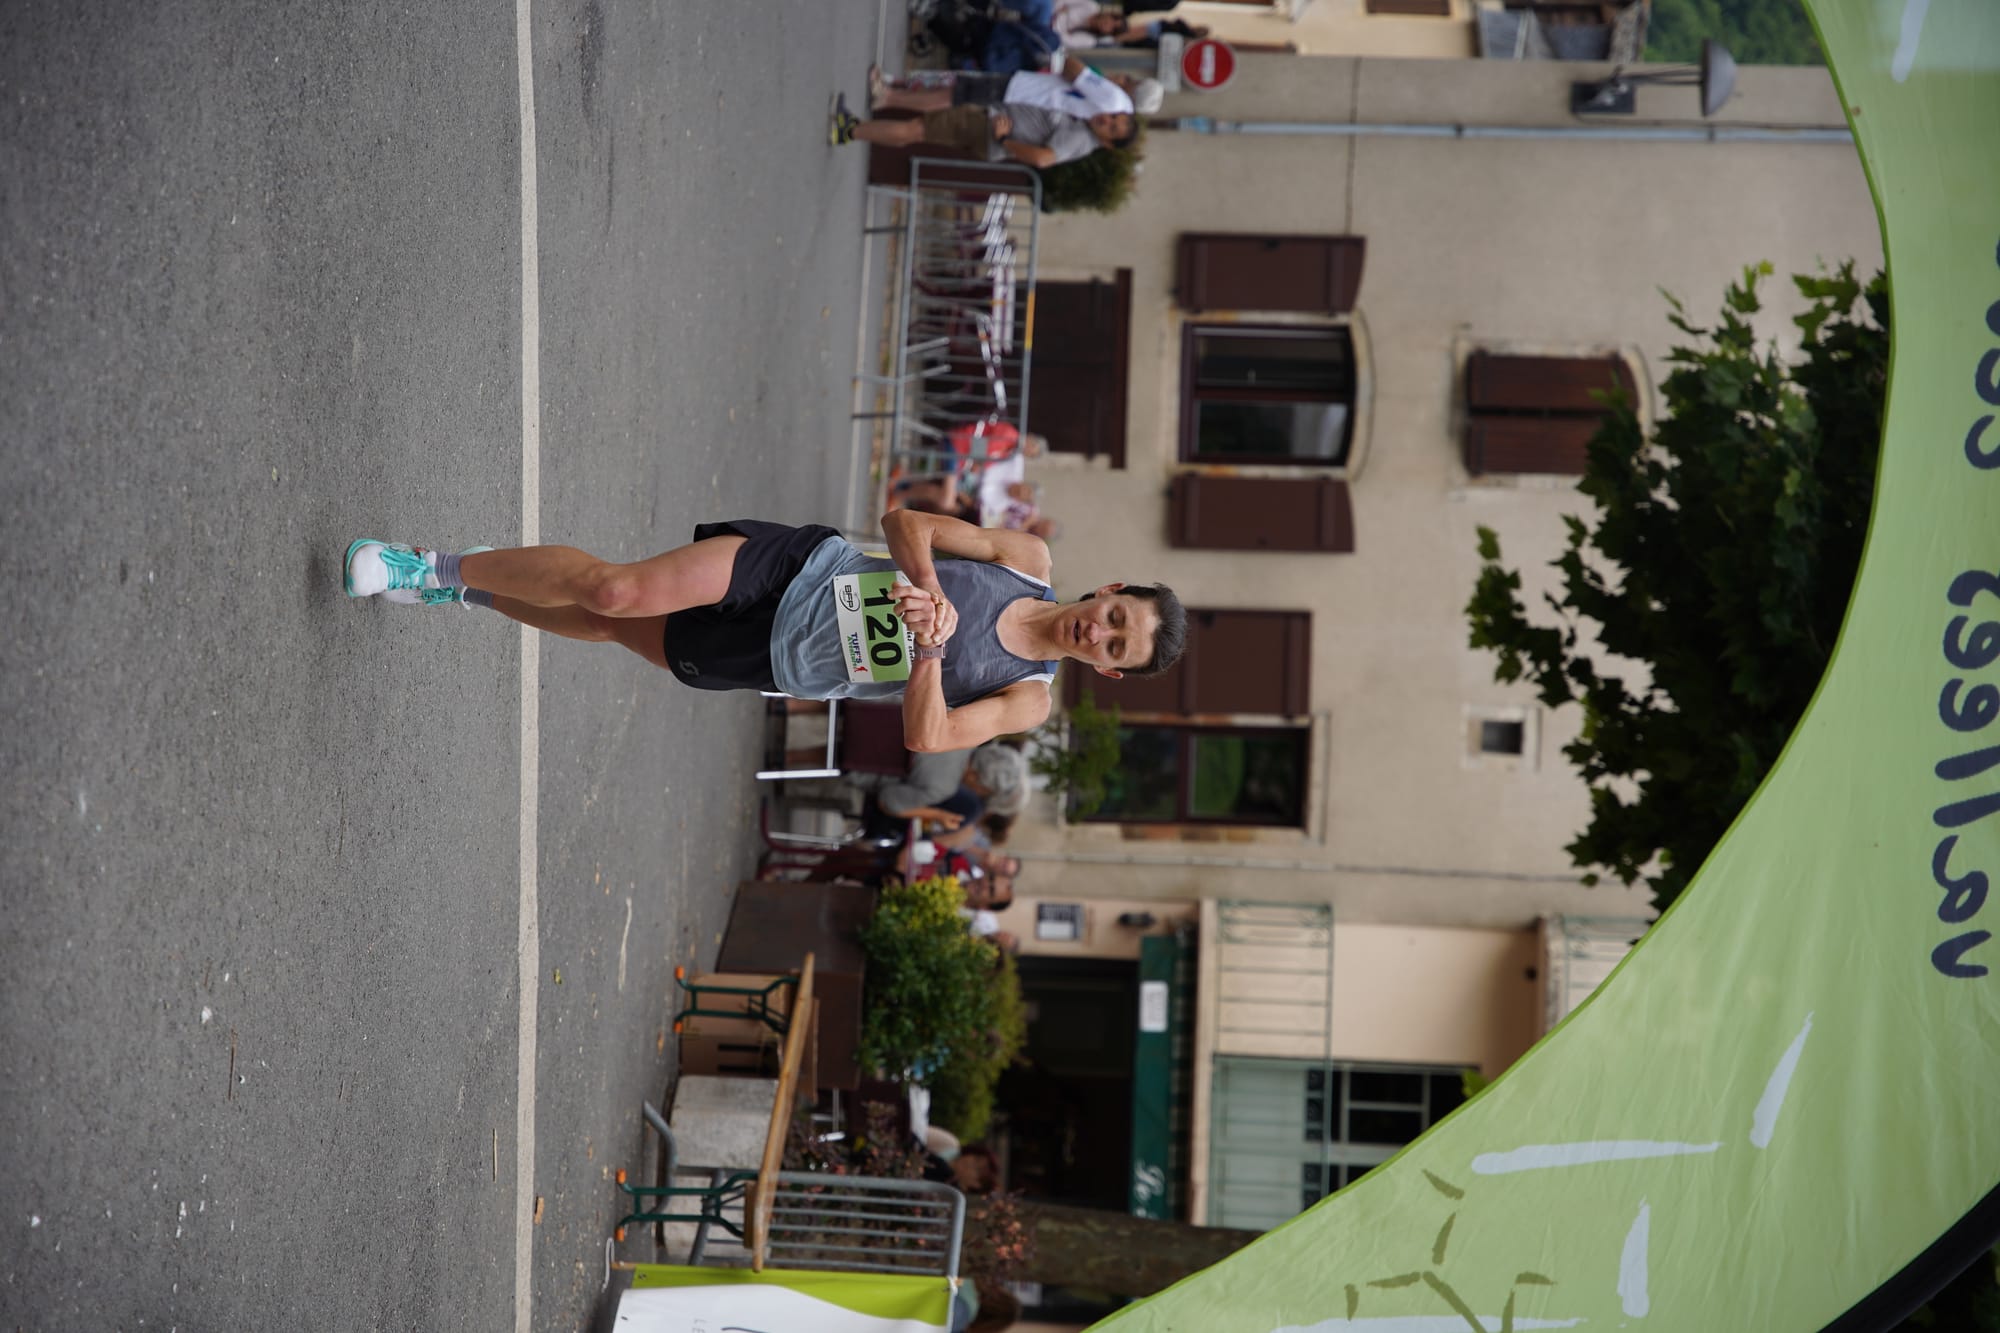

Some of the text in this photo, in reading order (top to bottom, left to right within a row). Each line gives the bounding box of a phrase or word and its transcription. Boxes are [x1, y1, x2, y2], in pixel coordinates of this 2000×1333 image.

[844, 585, 854, 608] BFP
[864, 588, 902, 666] 120
[851, 632, 862, 663] TUFF'S
